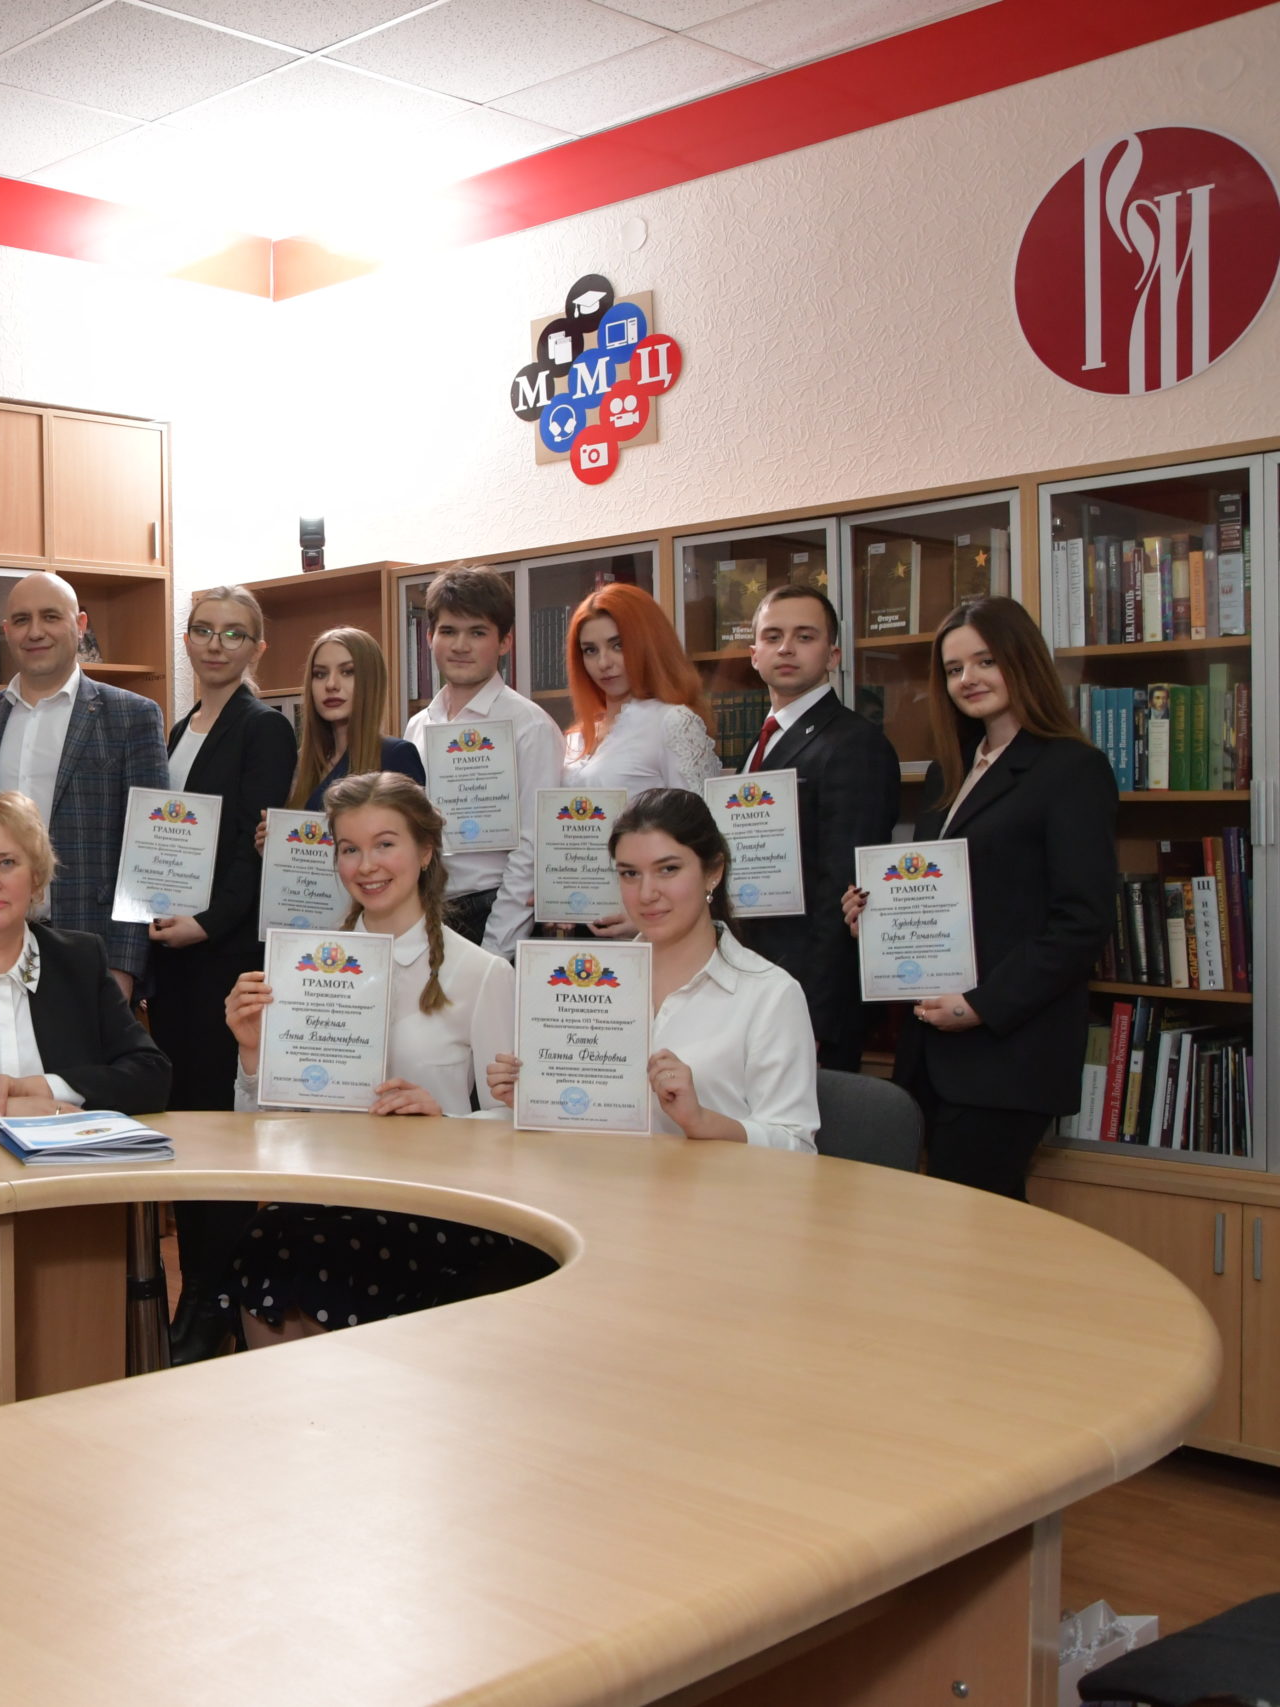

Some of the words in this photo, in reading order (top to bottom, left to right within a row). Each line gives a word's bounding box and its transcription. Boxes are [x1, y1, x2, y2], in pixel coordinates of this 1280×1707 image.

[453, 755, 490, 764] ГРАМОТА
[731, 811, 770, 821] ГРАМОТА
[152, 826, 192, 836] ГРАМОТА
[291, 848, 328, 857] ГРАМОТА
[890, 884, 938, 895] ГРАМОТА
[302, 978, 355, 989] ГРАМОТА
[304, 991, 351, 999] Награждается
[556, 993, 613, 1004] ГРАМОТА
[558, 1006, 609, 1014] Награждается
[306, 1015, 346, 1028] Бережная
[278, 1029, 304, 1041] Анна
[309, 1030, 370, 1046] Владимировна
[567, 1033, 599, 1045] Котюк
[538, 1048, 574, 1061] Полина
[579, 1049, 627, 1063] Фёдоровна
